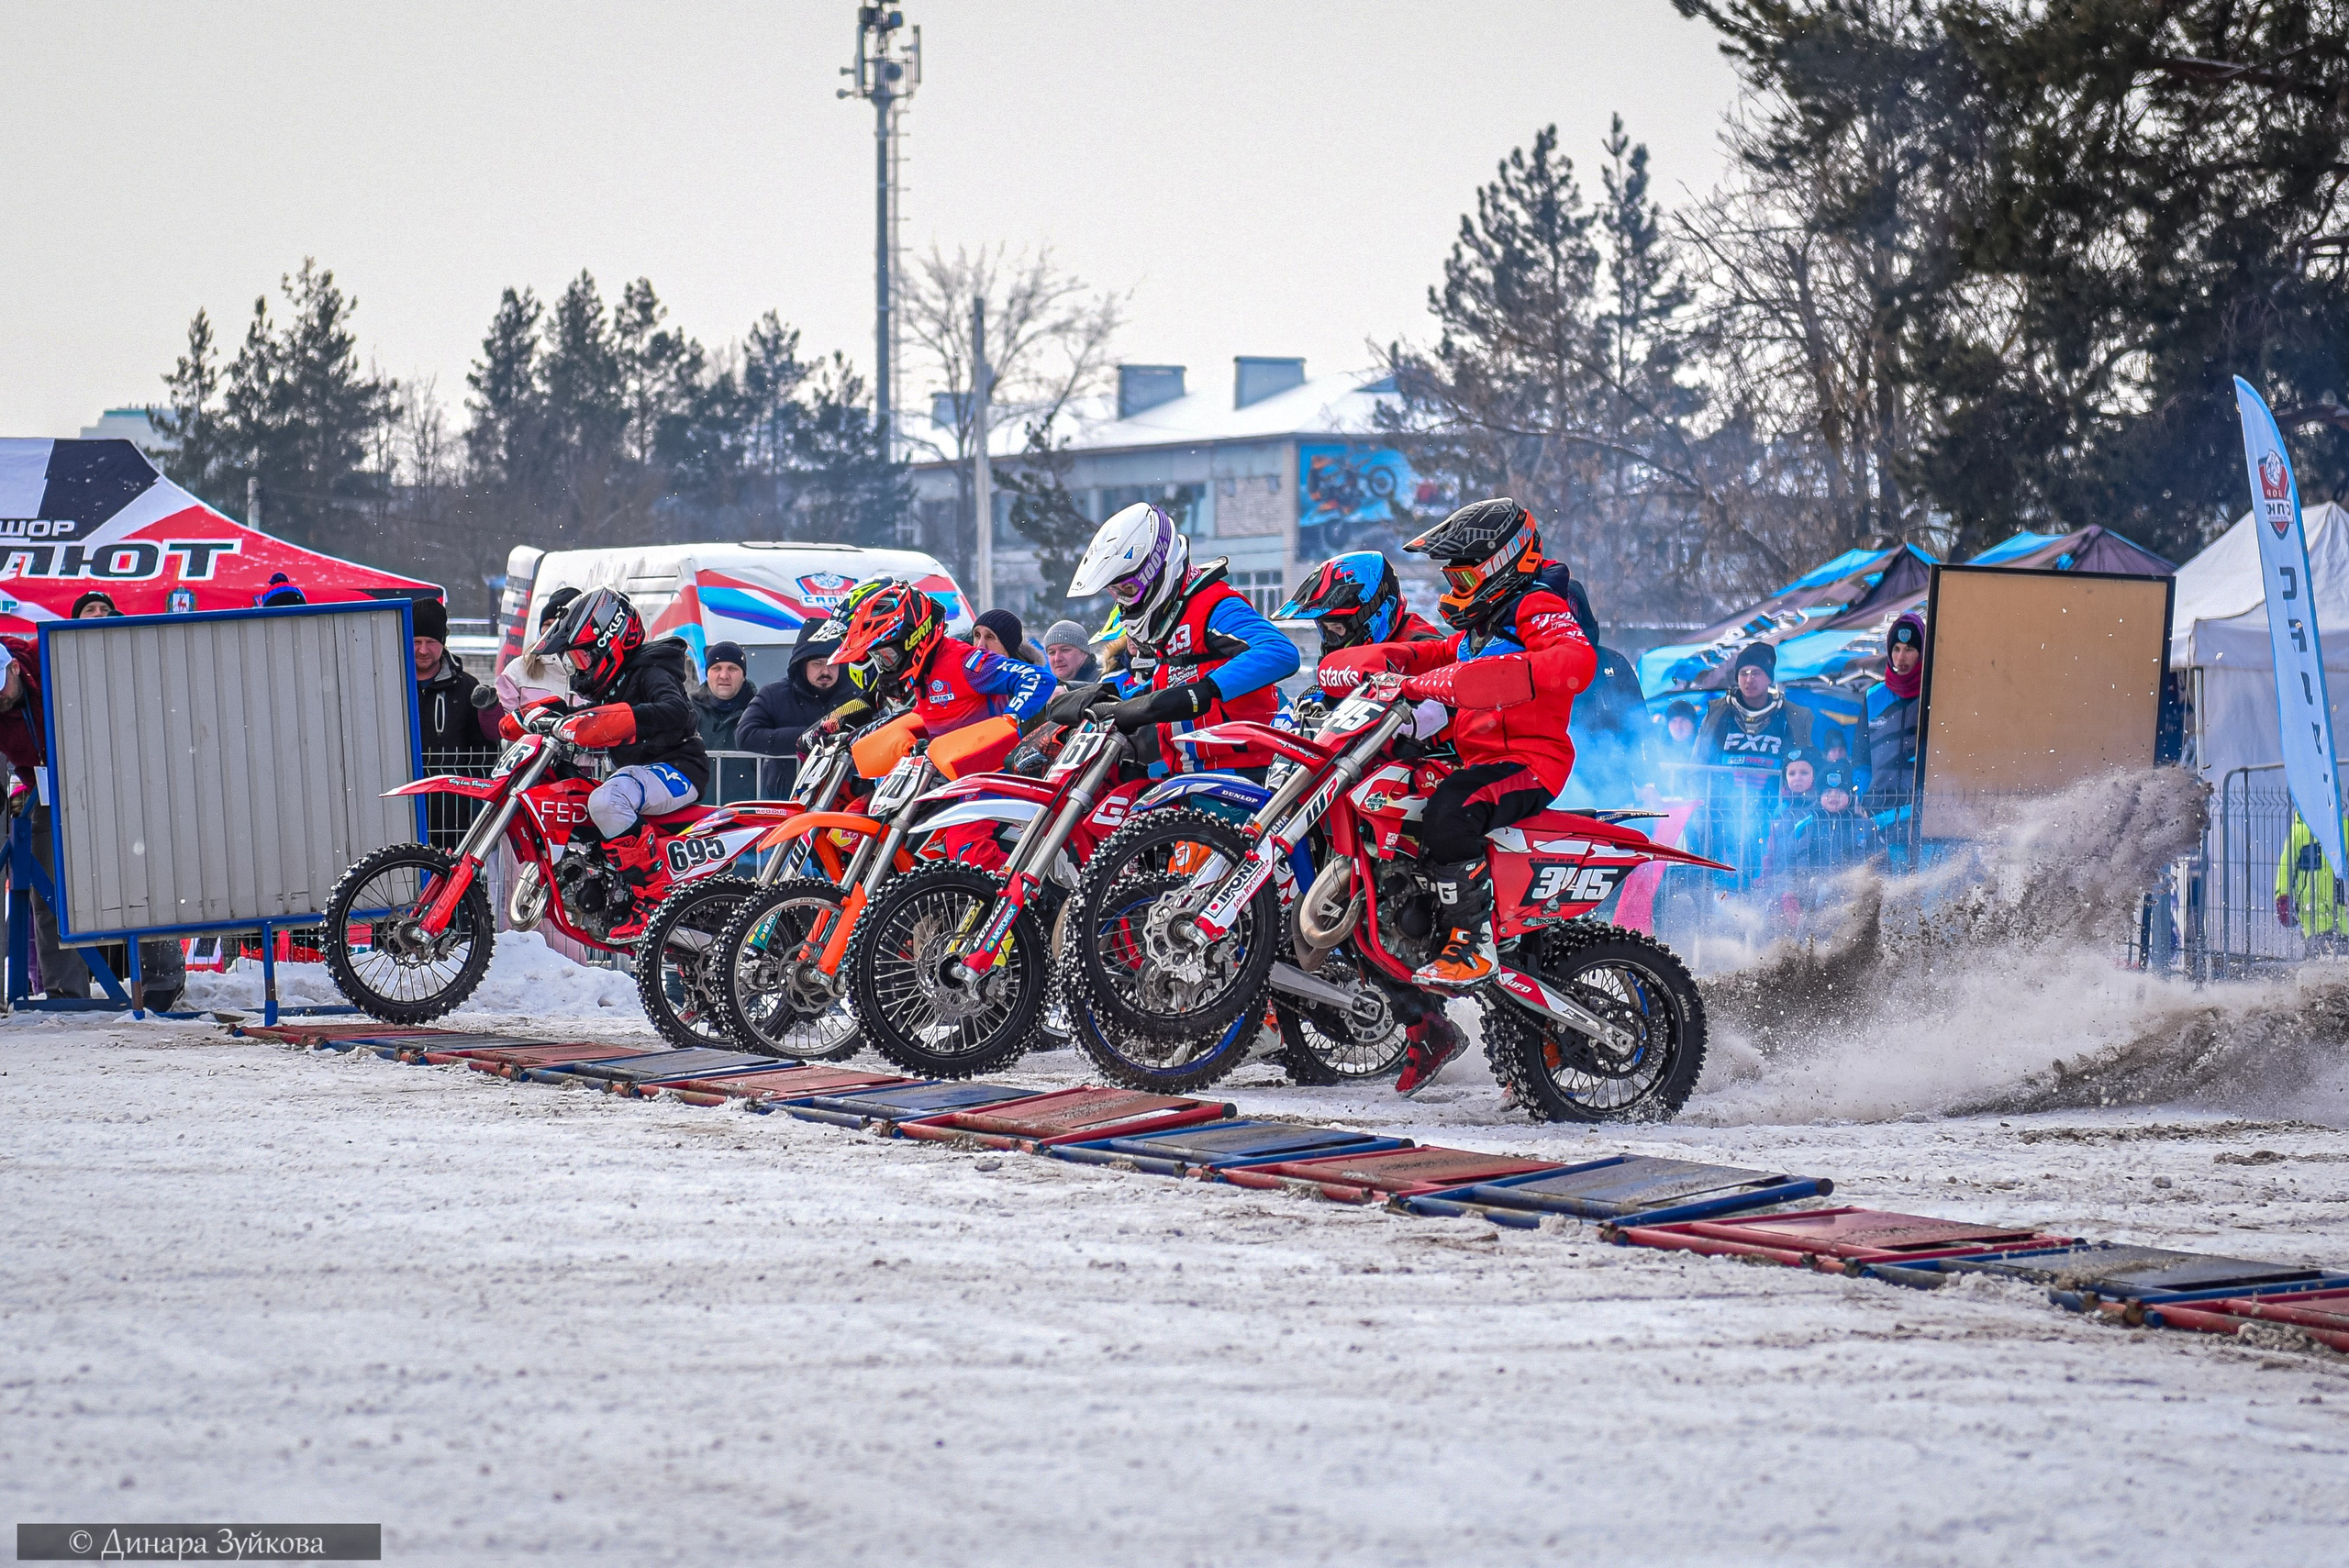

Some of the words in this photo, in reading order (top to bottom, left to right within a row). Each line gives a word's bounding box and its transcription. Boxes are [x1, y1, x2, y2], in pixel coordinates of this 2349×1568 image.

[1136, 537, 1168, 586] 100%
[1481, 526, 1532, 579] 100%
[1349, 582, 1389, 630] 100%
[597, 606, 626, 648] OAKLEY
[904, 615, 932, 651] LEATT
[1319, 665, 1359, 687] starks
[1060, 734, 1100, 765] 61
[1724, 732, 1782, 755] FXR
[1221, 789, 1258, 804] DUNLOP
[666, 835, 727, 873] 695
[1218, 859, 1261, 905] IPONE
[1531, 866, 1619, 901] 345
[974, 896, 1007, 950] DUNLOP
[992, 906, 1017, 940] MOTOREX
[1508, 981, 1532, 994] UFO
